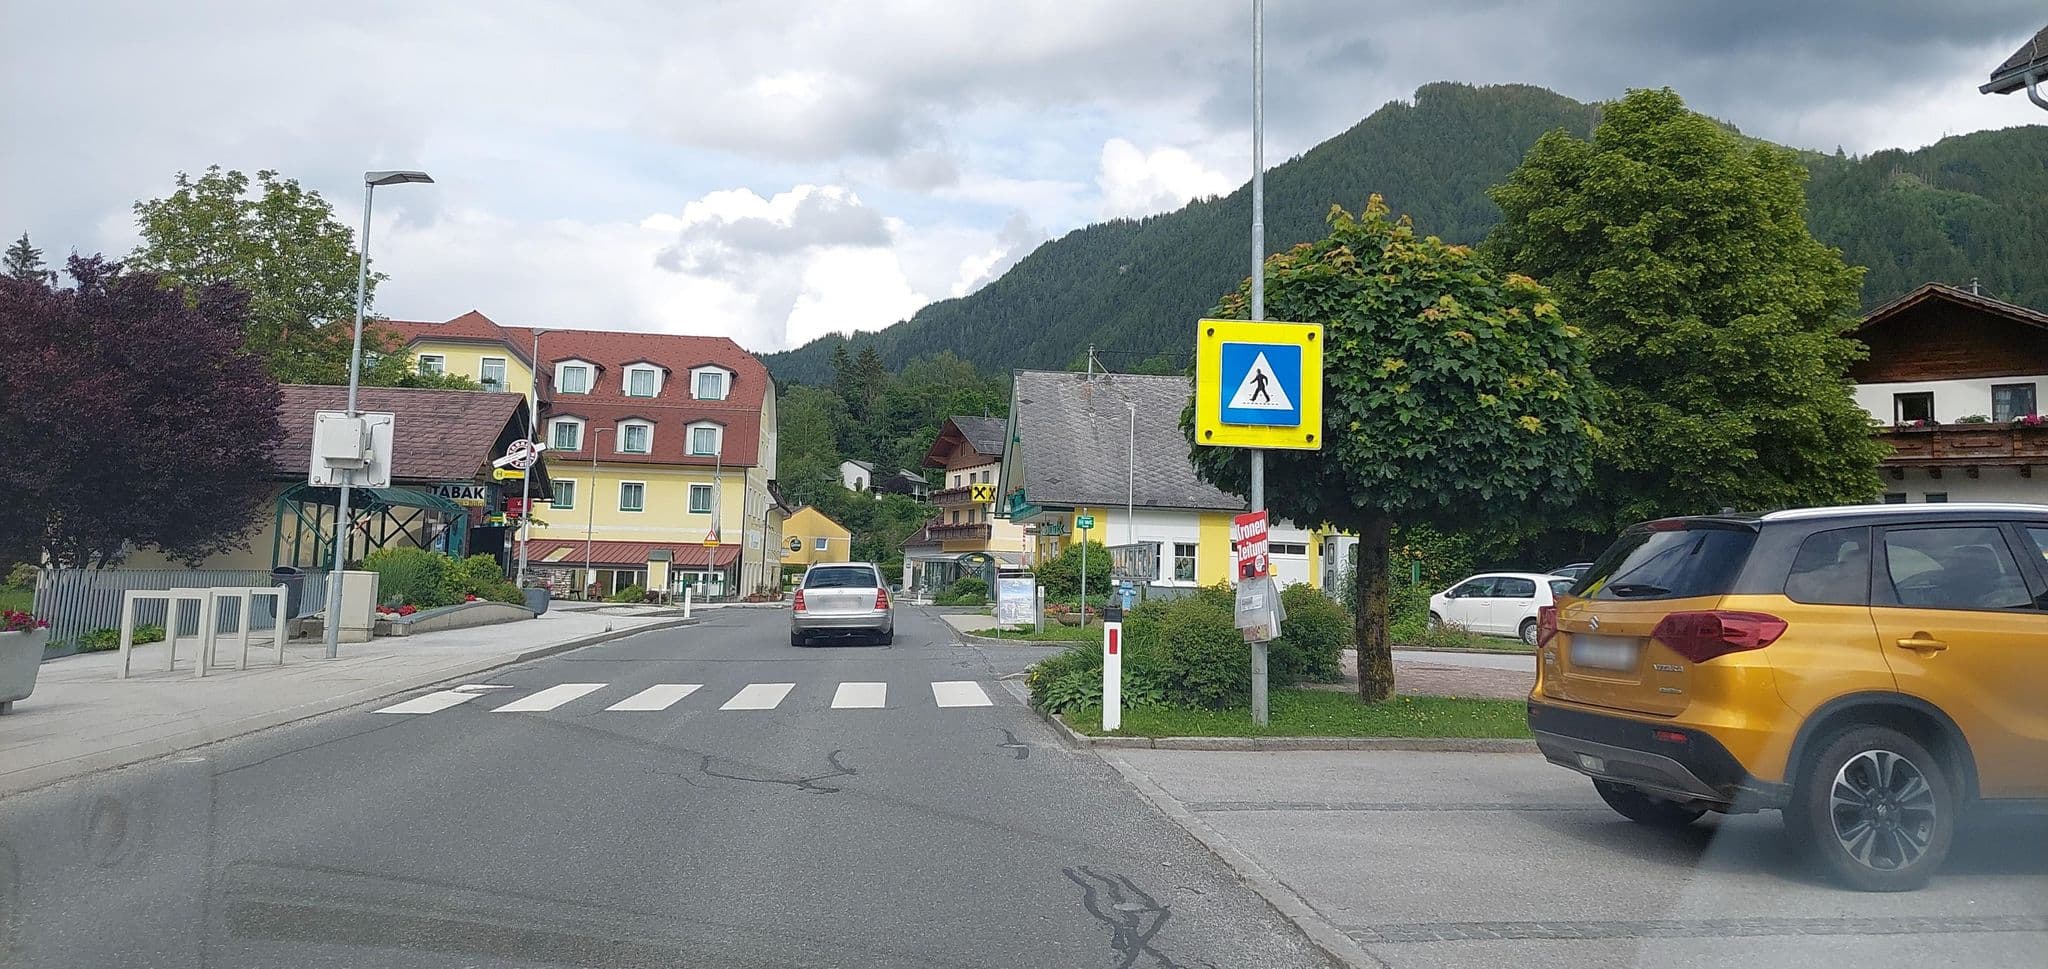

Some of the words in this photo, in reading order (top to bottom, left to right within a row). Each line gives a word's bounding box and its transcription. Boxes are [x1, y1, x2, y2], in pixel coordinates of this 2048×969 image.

[431, 485, 485, 499] TABAK
[1236, 518, 1266, 541] Kronen
[1237, 539, 1267, 562] Zeitung
